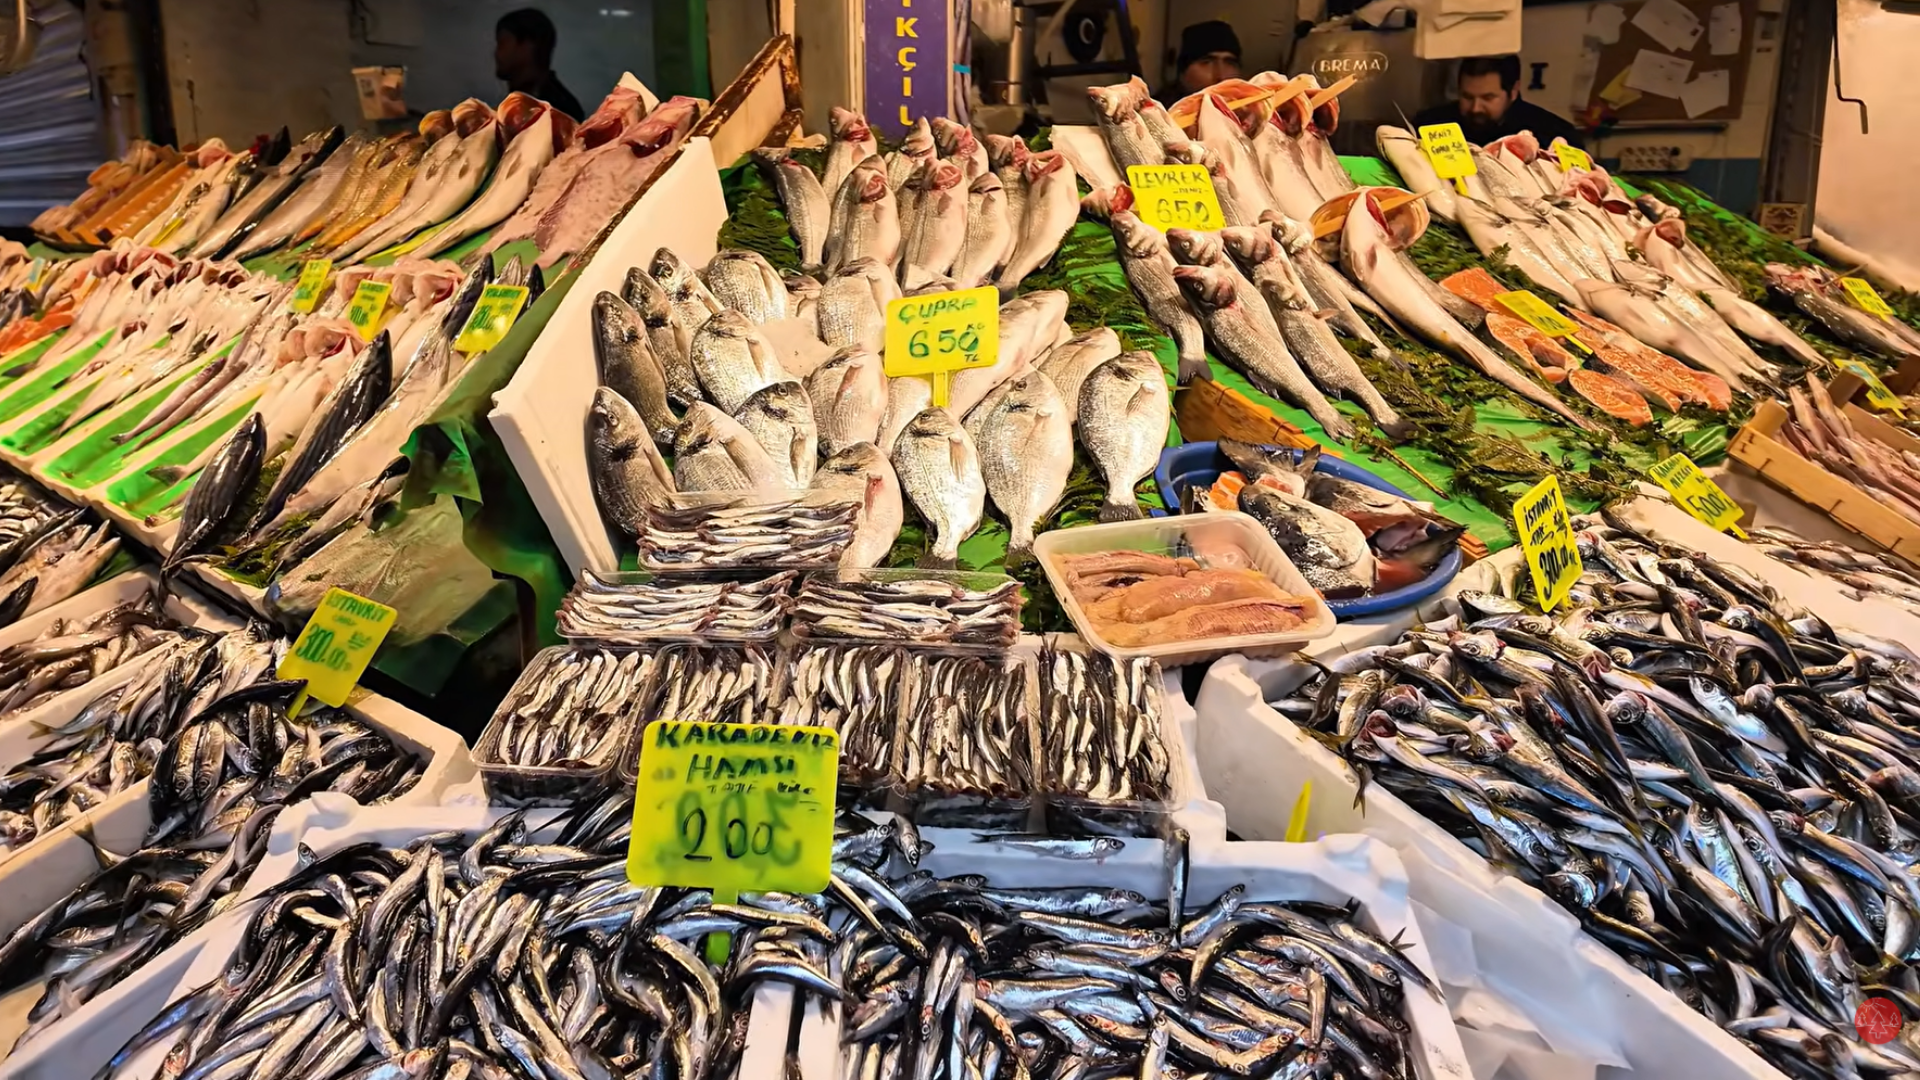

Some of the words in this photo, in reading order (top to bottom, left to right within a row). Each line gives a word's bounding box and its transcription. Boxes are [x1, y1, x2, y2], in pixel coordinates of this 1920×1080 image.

[1320, 58, 1381, 73] BREMA
[1134, 169, 1207, 189] LEVREK
[1156, 198, 1210, 224] 650
[898, 298, 977, 325] ÇUPRA
[909, 329, 979, 358] 650
[1686, 493, 1727, 527] 500
[683, 807, 774, 862] 200
